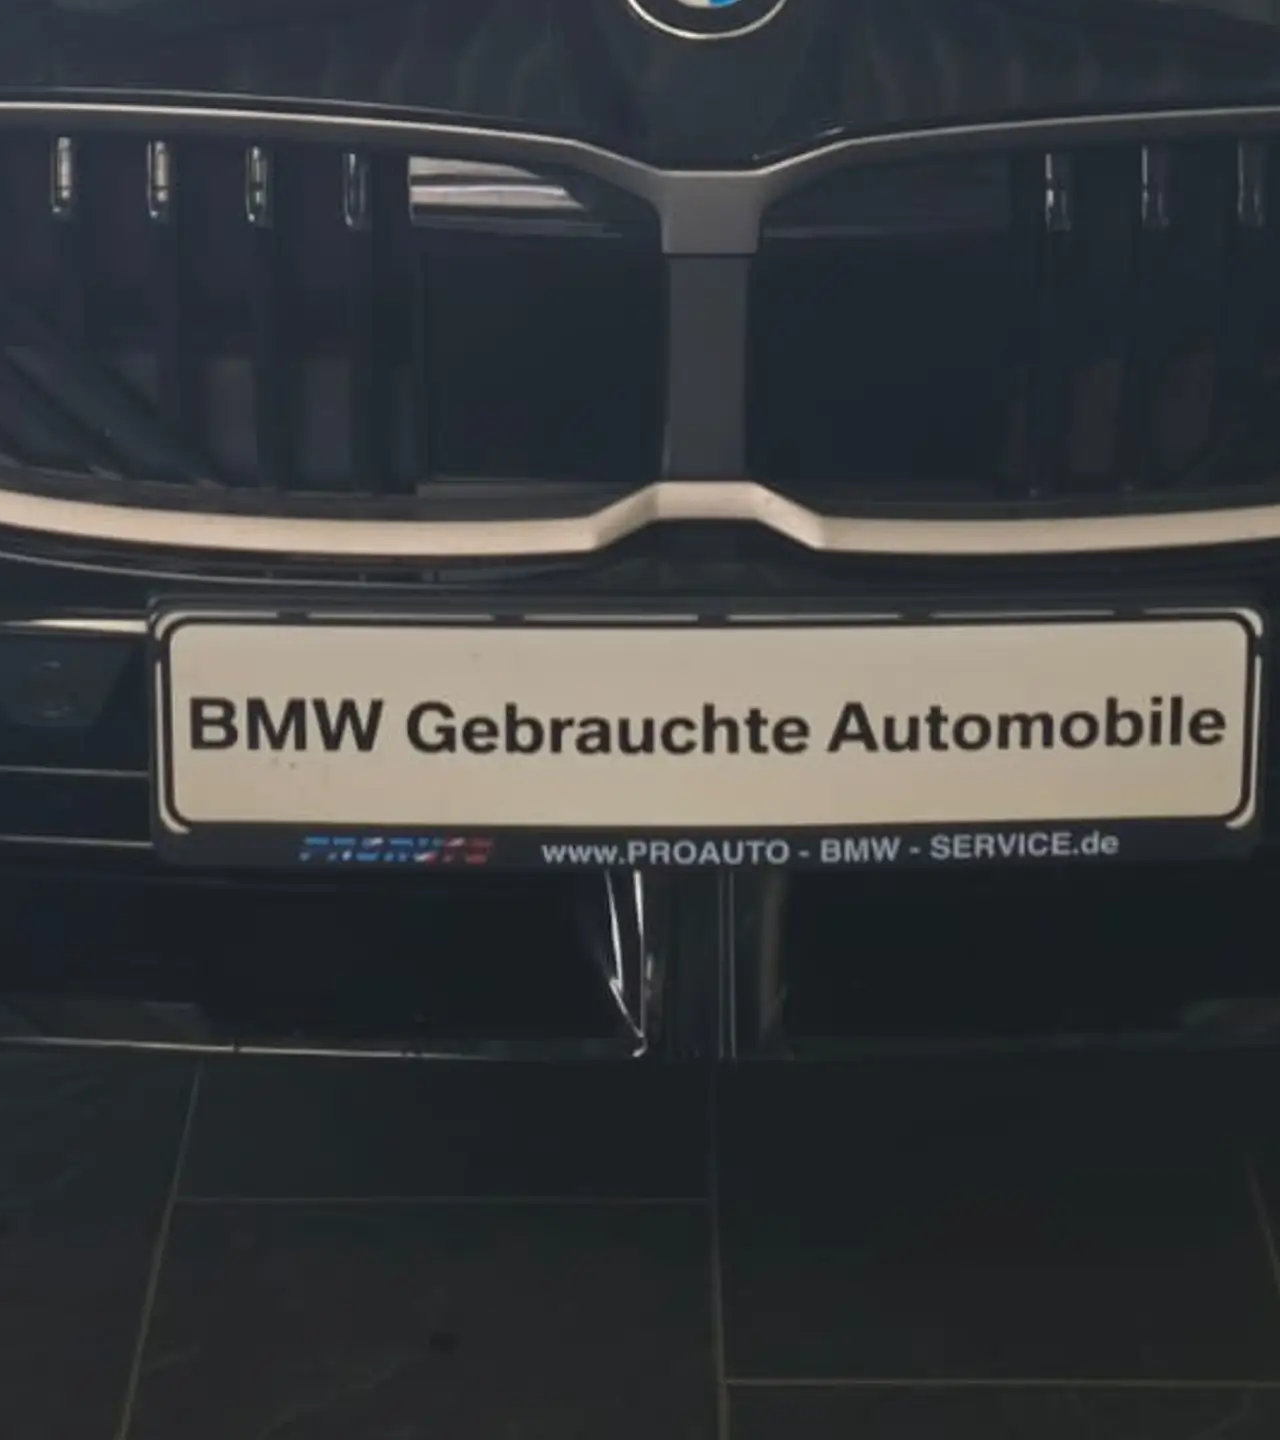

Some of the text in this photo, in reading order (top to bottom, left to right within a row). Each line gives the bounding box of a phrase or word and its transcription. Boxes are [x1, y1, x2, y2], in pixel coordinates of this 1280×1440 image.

[188, 696, 1227, 755] BMW Gebrauchte Automobile
[820, 837, 901, 864] BMW
[929, 830, 1120, 860] SERVICE.de
